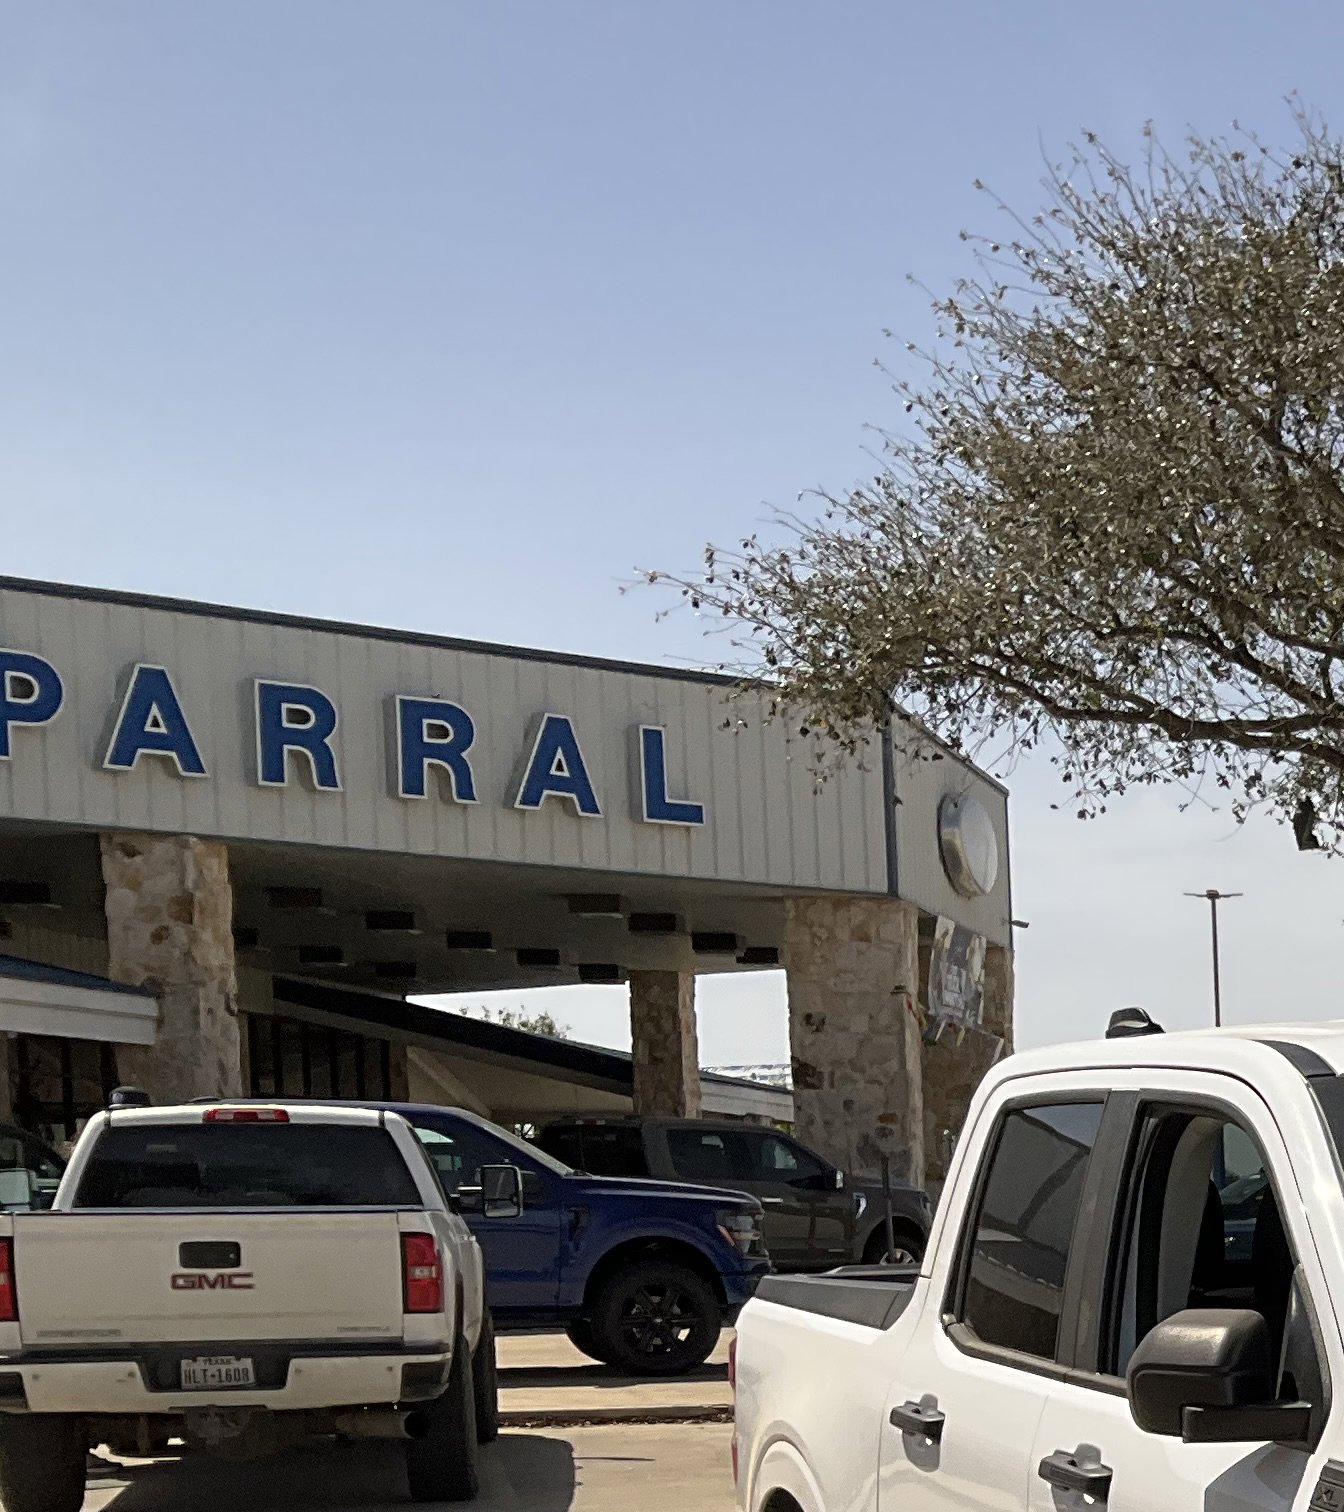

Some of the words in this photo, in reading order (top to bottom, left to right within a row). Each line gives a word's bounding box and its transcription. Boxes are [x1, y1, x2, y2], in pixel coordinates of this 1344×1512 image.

[0, 647, 705, 827] PARRAL
[171, 1271, 256, 1290] GMC
[1315, 1487, 1339, 1508] XL
